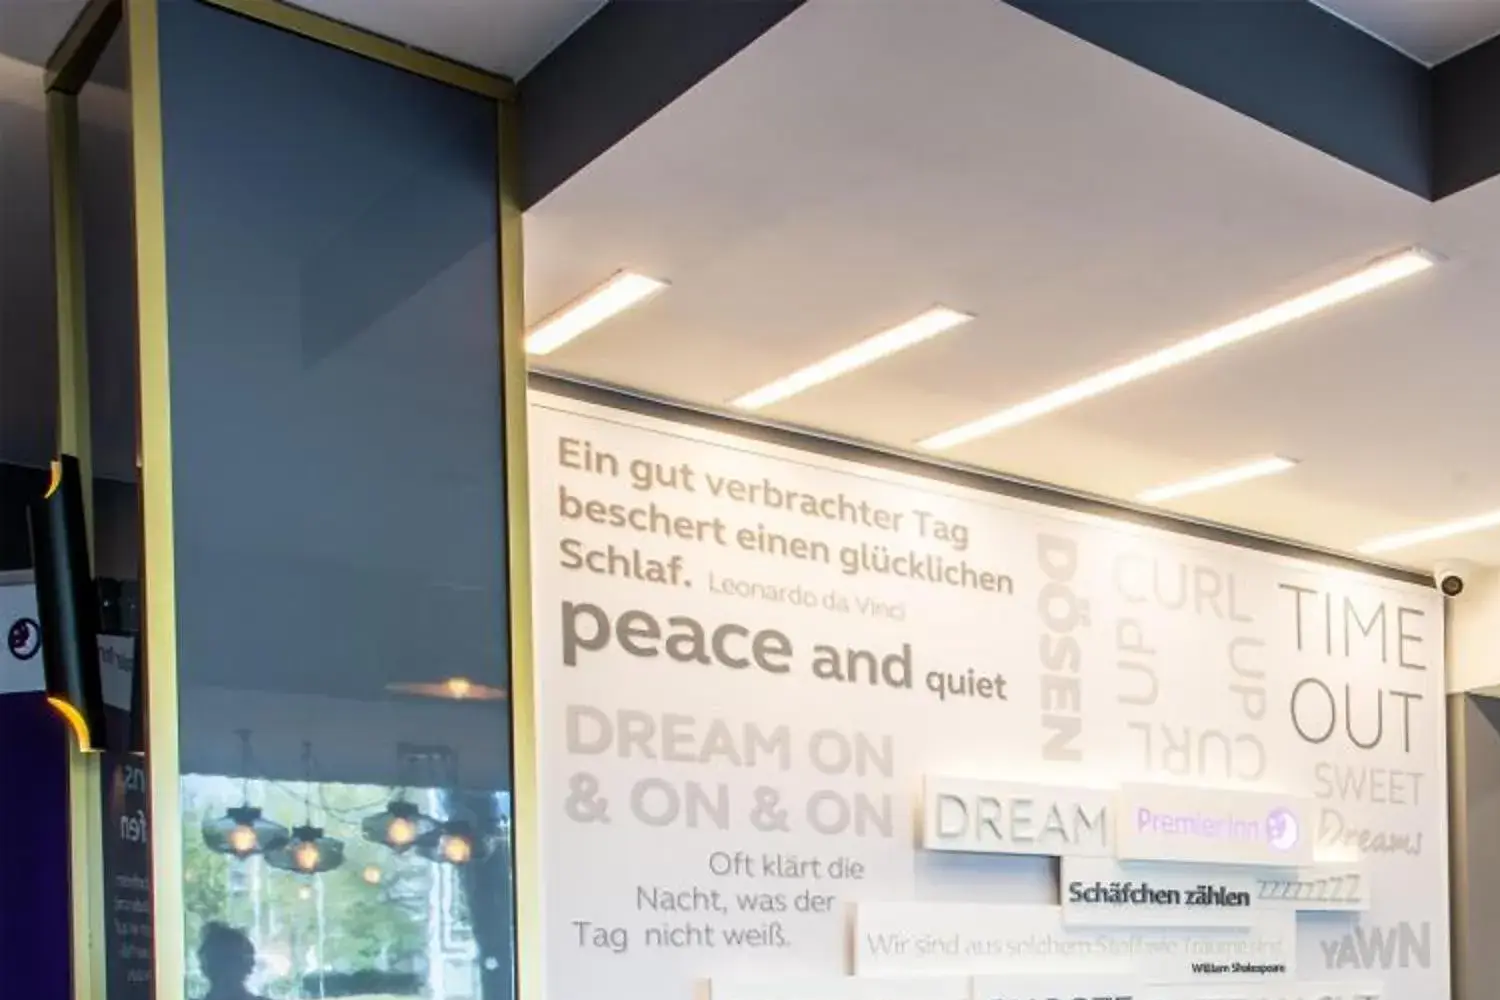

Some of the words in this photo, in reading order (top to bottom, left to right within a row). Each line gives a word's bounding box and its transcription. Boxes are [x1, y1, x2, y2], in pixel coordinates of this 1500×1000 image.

[558, 436, 618, 477] Ein
[630, 458, 694, 494] gut
[707, 471, 904, 532] verbrachter
[912, 509, 969, 551] Tag
[559, 486, 726, 546] beschert
[737, 522, 830, 564] einen
[840, 541, 1014, 595] glücklichen
[559, 539, 693, 588] Schlaf.
[708, 571, 817, 609] Leonardo
[823, 588, 850, 614] da
[855, 589, 906, 622] Vinci
[1113, 550, 1254, 624] CURL
[561, 599, 792, 674] peace
[812, 643, 913, 690] and
[926, 667, 1008, 701] quiet
[1037, 533, 1091, 762] DÖSEN
[1116, 618, 1158, 706] UP
[1279, 583, 1427, 671] TIME
[1227, 636, 1267, 721] UP
[1290, 677, 1424, 753] OUT
[565, 704, 791, 771] DREAM
[808, 728, 894, 778] ON
[1126, 722, 1267, 782] CURL
[564, 771, 612, 825] &
[629, 777, 730, 831] ON
[749, 785, 790, 834] &
[805, 789, 893, 838] ON
[935, 794, 1108, 848] DREAM
[1314, 762, 1426, 806] SWEET
[708, 850, 754, 878] Oft
[762, 852, 821, 880] klärt
[828, 853, 865, 881] die
[1318, 808, 1423, 856] Dreams
[636, 886, 728, 915] Nacht,
[735, 891, 787, 912] was
[794, 888, 836, 914] der
[1068, 882, 1181, 906] Schäfchen
[1184, 886, 1251, 907] zählen
[573, 920, 628, 953] Tag
[644, 921, 715, 948] nicht
[723, 921, 790, 948] weiß.
[866, 932, 908, 956] Wir
[915, 932, 959, 956] sind
